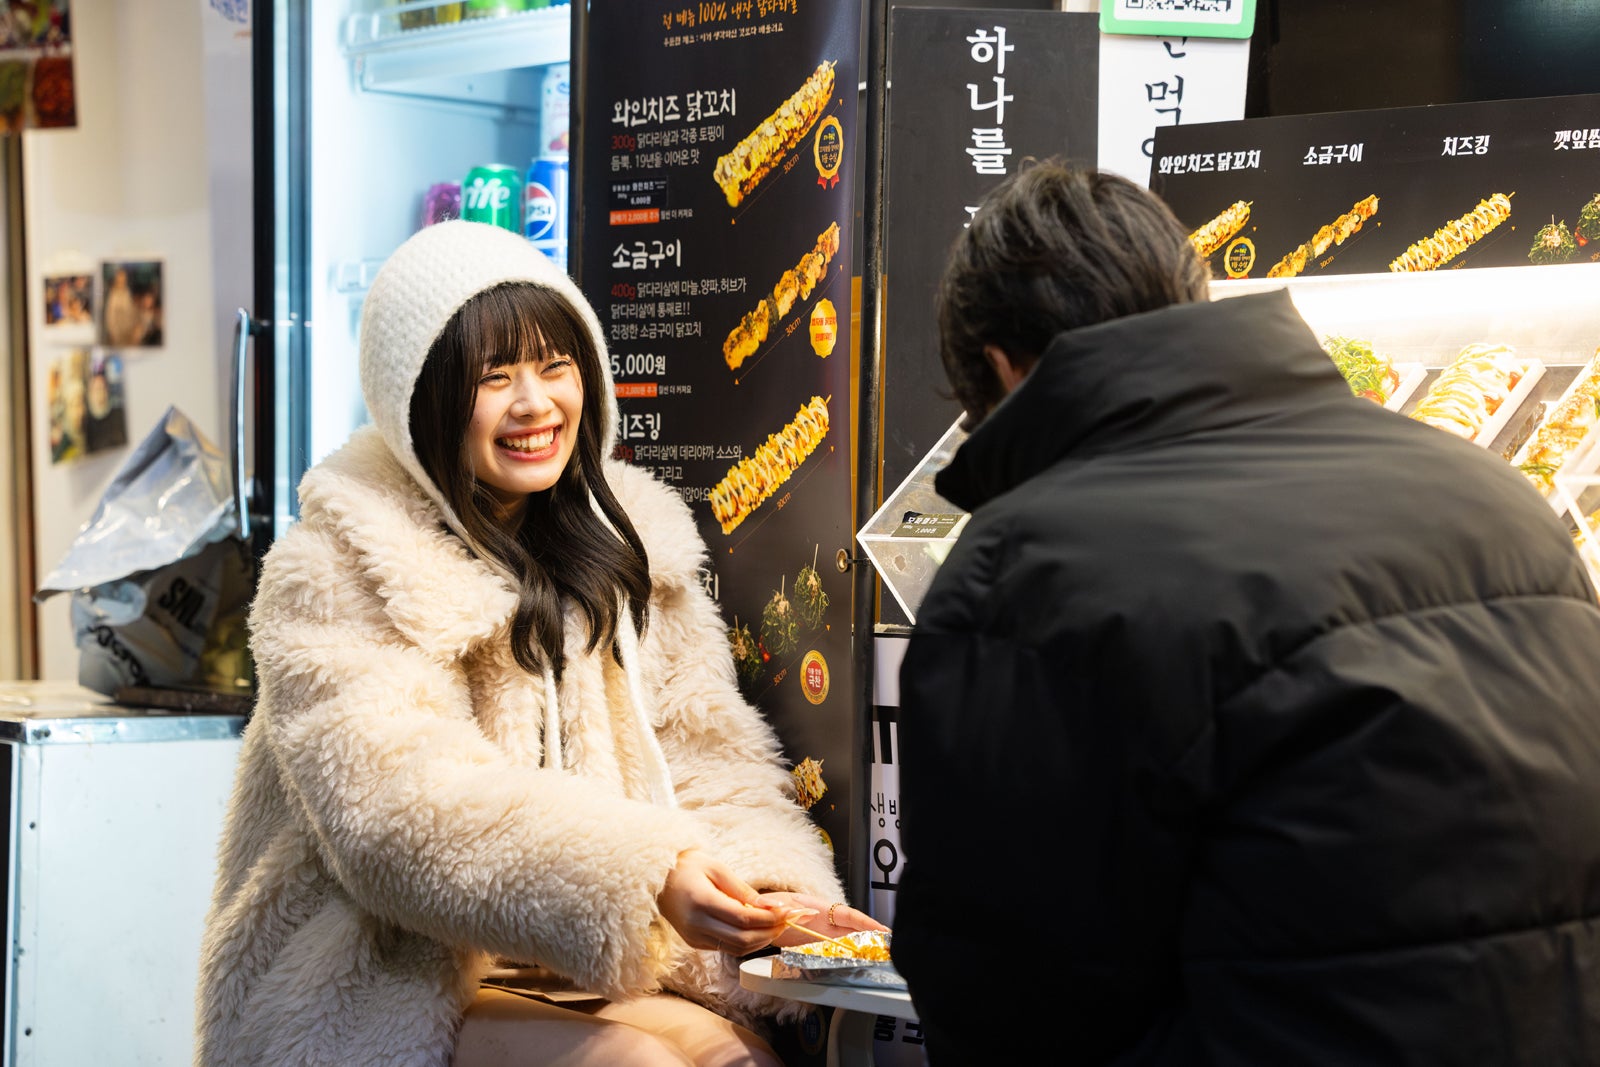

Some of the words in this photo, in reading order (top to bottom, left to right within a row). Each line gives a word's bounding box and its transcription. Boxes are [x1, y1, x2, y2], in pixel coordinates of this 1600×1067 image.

[675, 8, 696, 28] 메뉴
[698, 1, 727, 25] 100%
[611, 96, 681, 128] 와인치즈
[686, 87, 737, 123] 닭꼬치
[965, 26, 1015, 175] 하나를
[611, 134, 636, 152] 300g
[637, 128, 679, 149] 닭다리살과
[680, 126, 698, 145] 각종
[699, 124, 725, 142] 토핑이
[1441, 134, 1491, 157] 치즈킹
[635, 150, 663, 169] 19년을
[664, 147, 690, 168] 이어온
[690, 147, 701, 166] 맛
[1159, 153, 1215, 175] 와인치즈
[1217, 150, 1261, 172] 닭꼬치
[1303, 143, 1364, 166] 소금구이
[611, 238, 682, 271] 소금구이
[611, 283, 636, 301] 400g
[637, 281, 680, 299] 닭다리살에
[610, 303, 656, 320] 닭다리살에
[610, 324, 638, 340] 진정한
[640, 322, 674, 340] 소금구이
[675, 321, 702, 339] 닭꼬치
[610, 353, 666, 377] 5,000원
[634, 445, 678, 461] 닭다리살에
[716, 445, 742, 460] 소스와
[656, 466, 683, 481] 그리고
